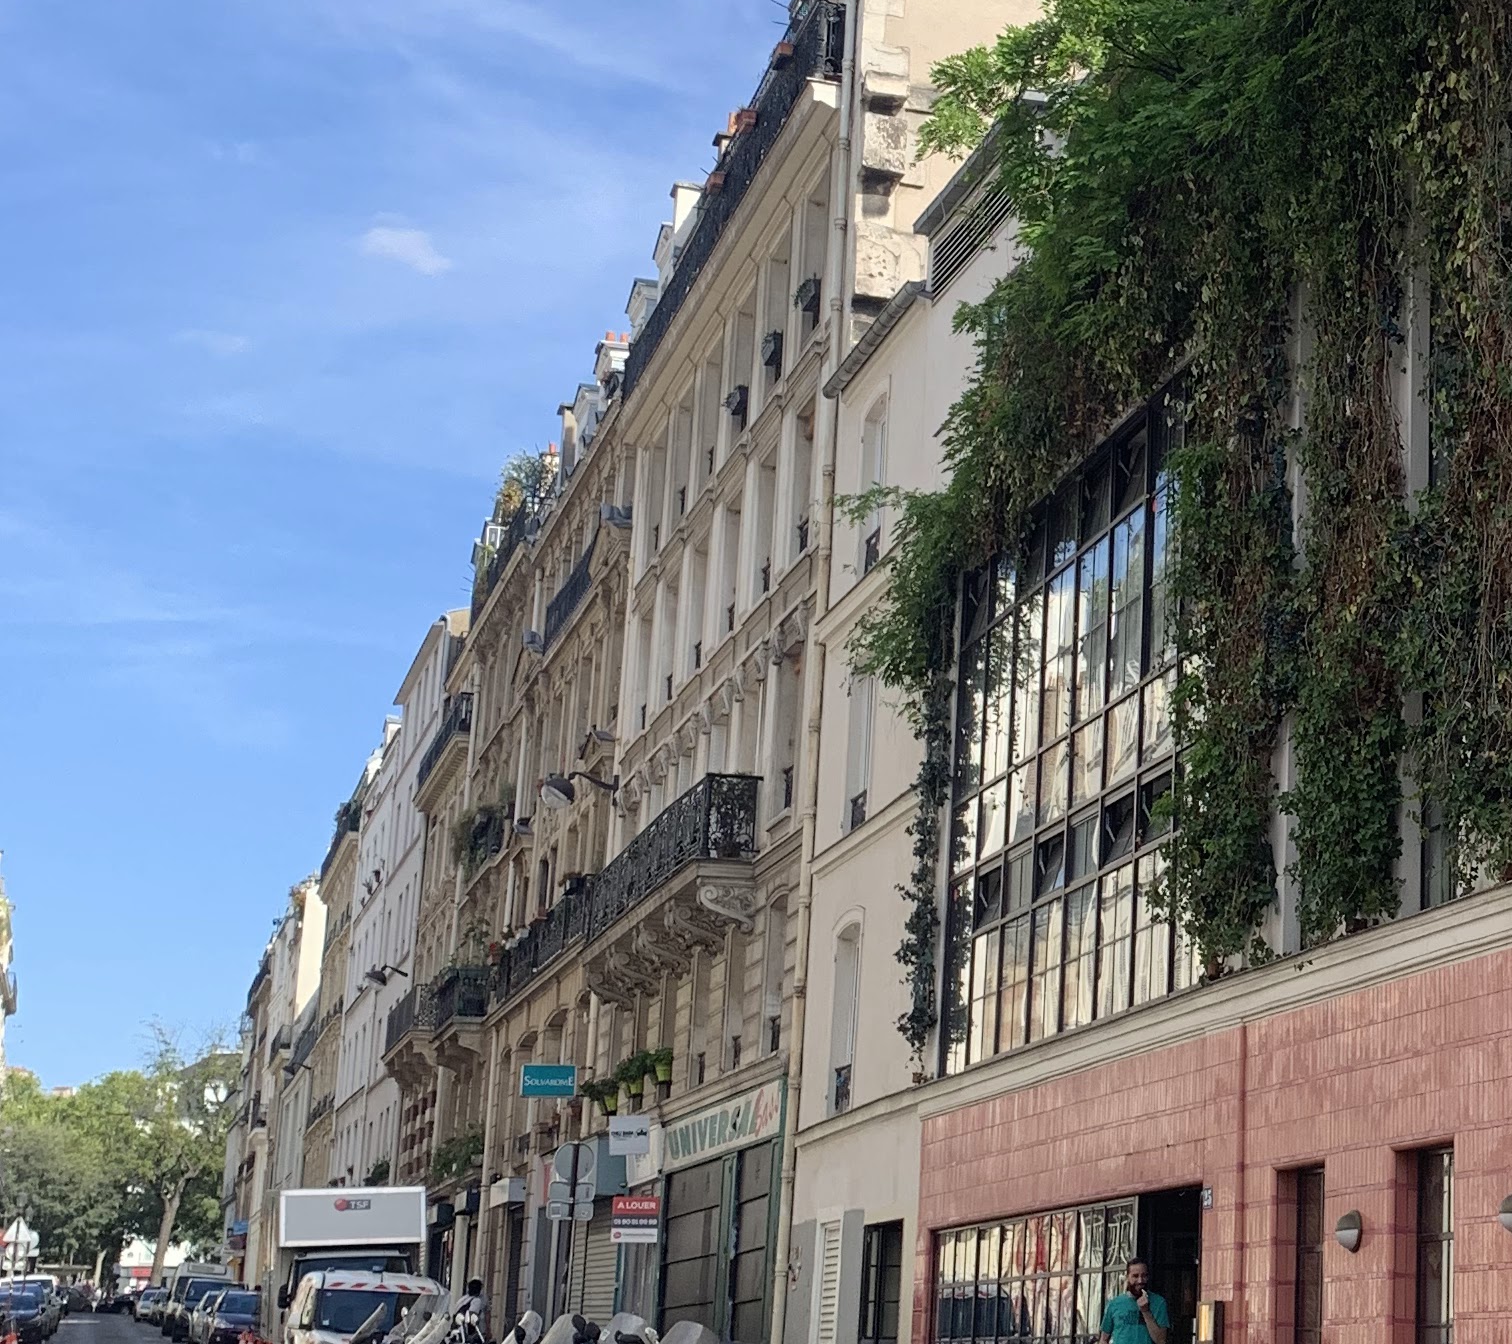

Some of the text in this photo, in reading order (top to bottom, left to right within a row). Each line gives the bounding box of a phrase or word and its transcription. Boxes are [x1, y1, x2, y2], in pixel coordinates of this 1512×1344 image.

[667, 1097, 758, 1161] UNIVERSAL
[350, 1200, 369, 1209] TSF
[617, 1201, 656, 1210] A LOUER
